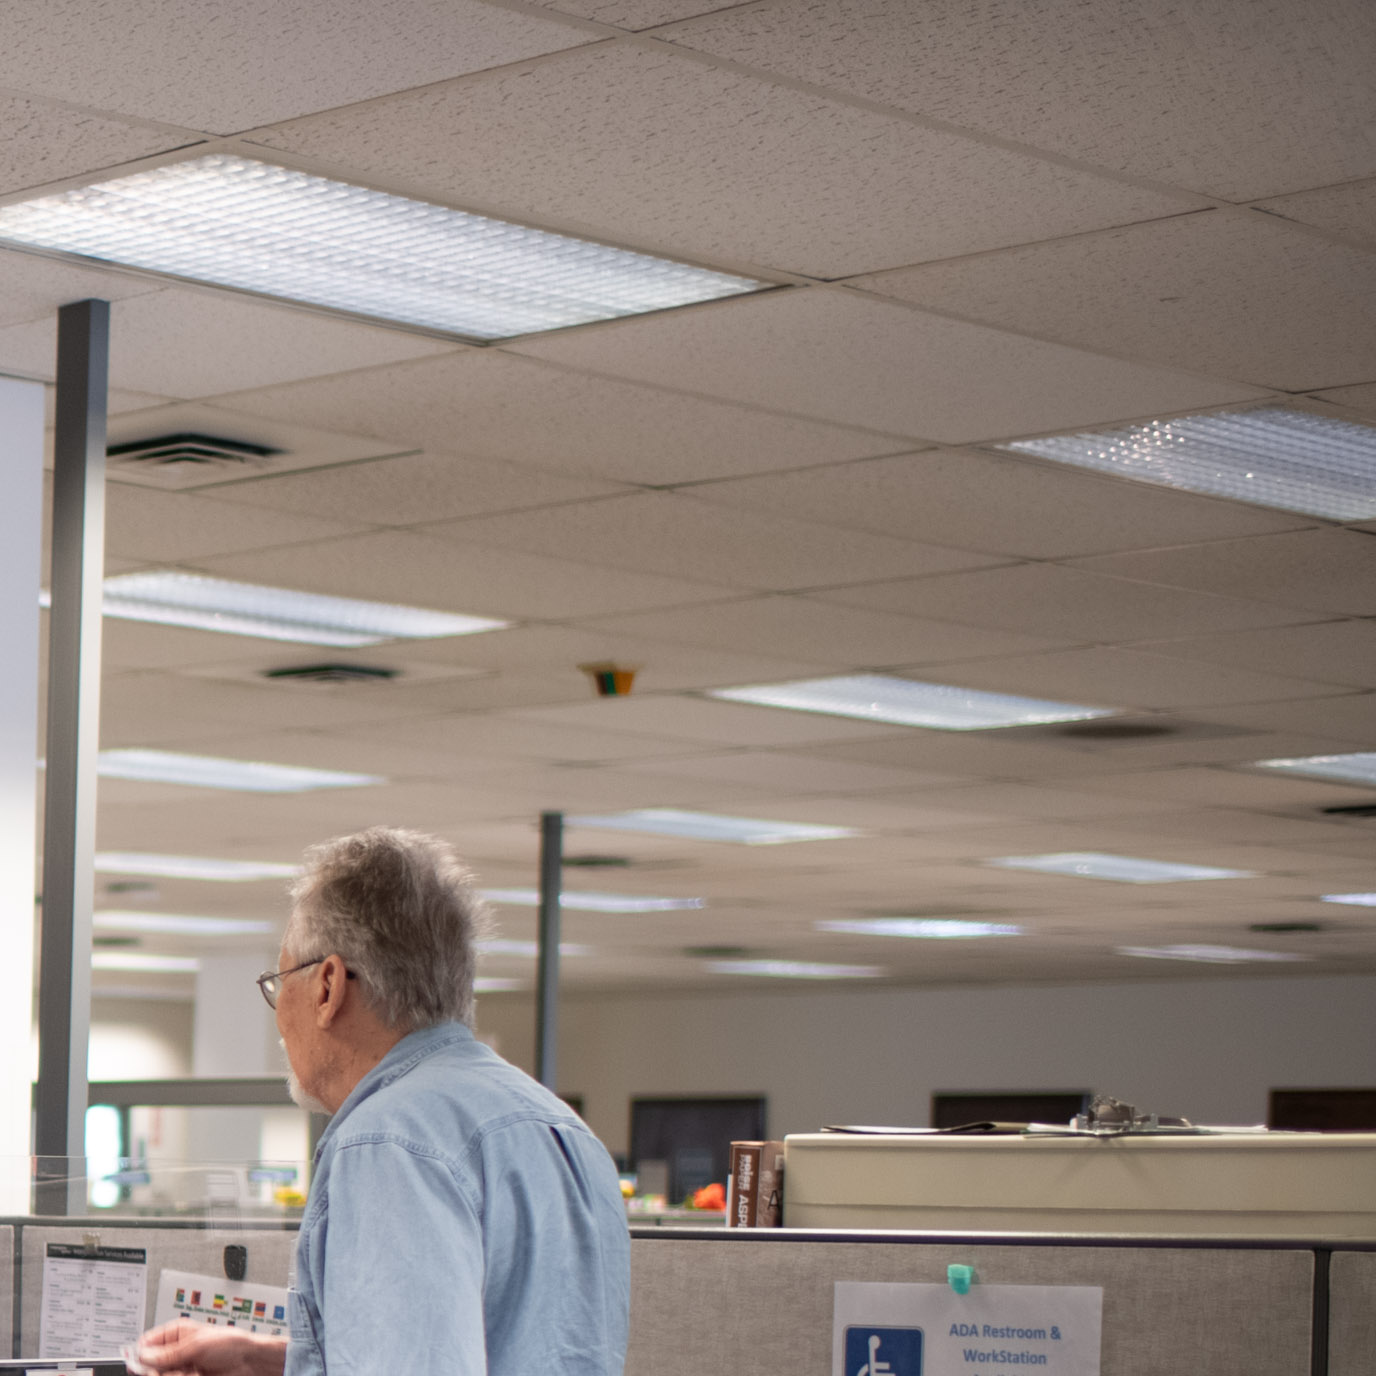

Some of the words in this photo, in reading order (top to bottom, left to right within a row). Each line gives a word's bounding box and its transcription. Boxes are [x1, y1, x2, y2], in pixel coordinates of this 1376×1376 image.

[949, 1323, 979, 1337] ADA
[982, 1324, 1047, 1340] Restroom
[1050, 1326, 1061, 1340] &
[963, 1348, 1047, 1365] WorkStation
